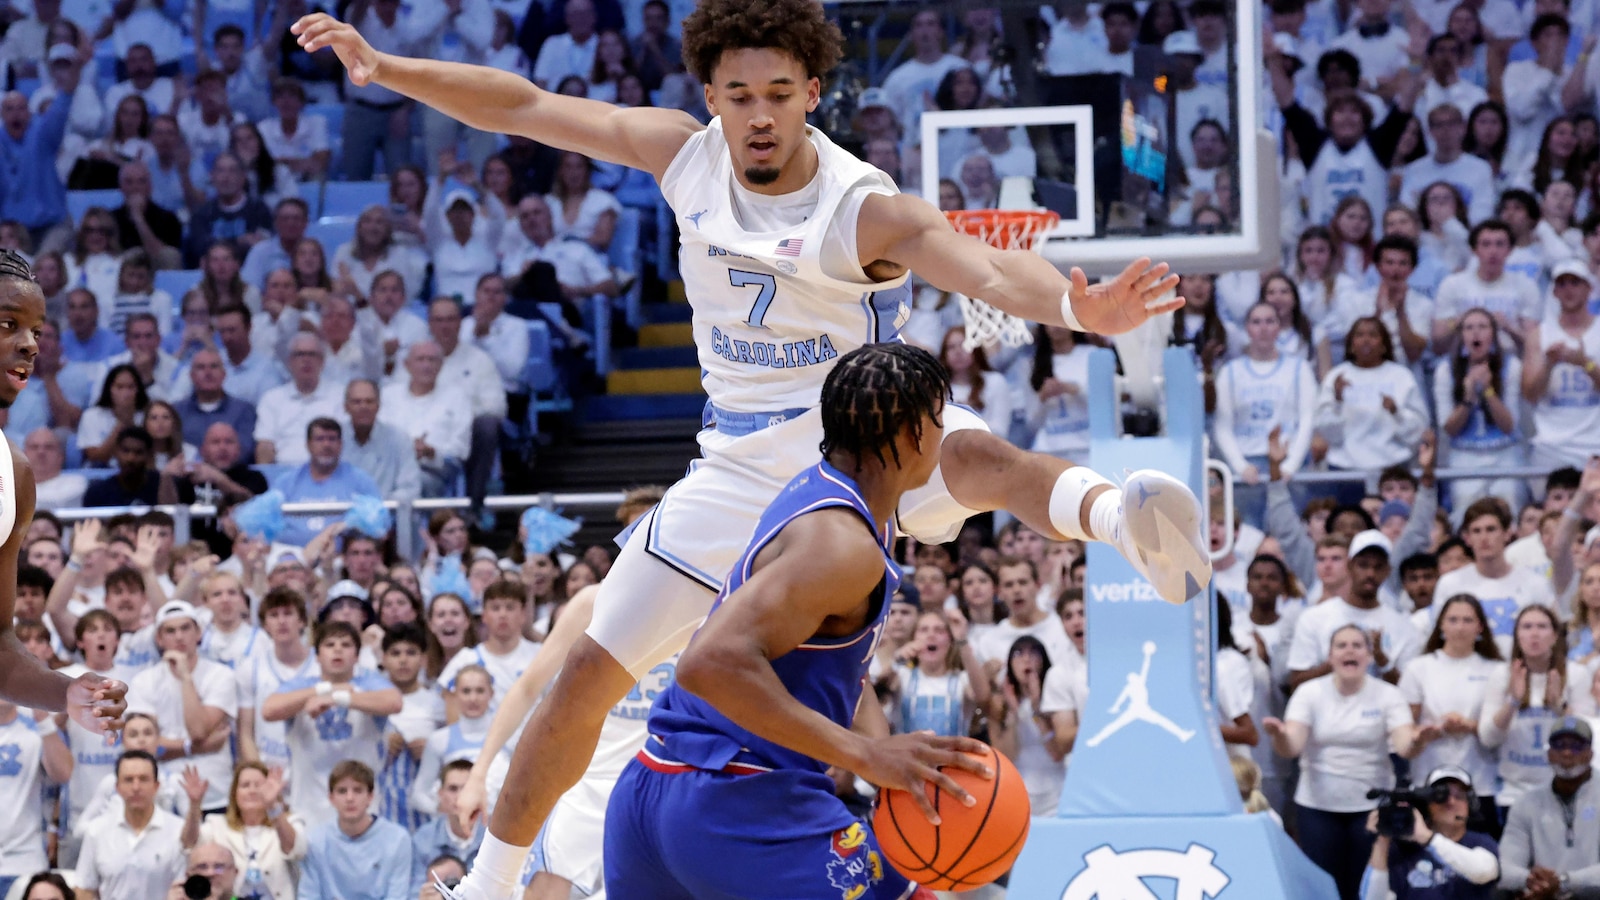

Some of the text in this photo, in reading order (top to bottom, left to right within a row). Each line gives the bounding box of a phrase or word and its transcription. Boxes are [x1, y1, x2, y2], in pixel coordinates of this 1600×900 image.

[728, 268, 777, 330] 7
[711, 325, 838, 368] CAROLINA
[1091, 578, 1165, 602] veriz
[846, 856, 865, 877] KU
